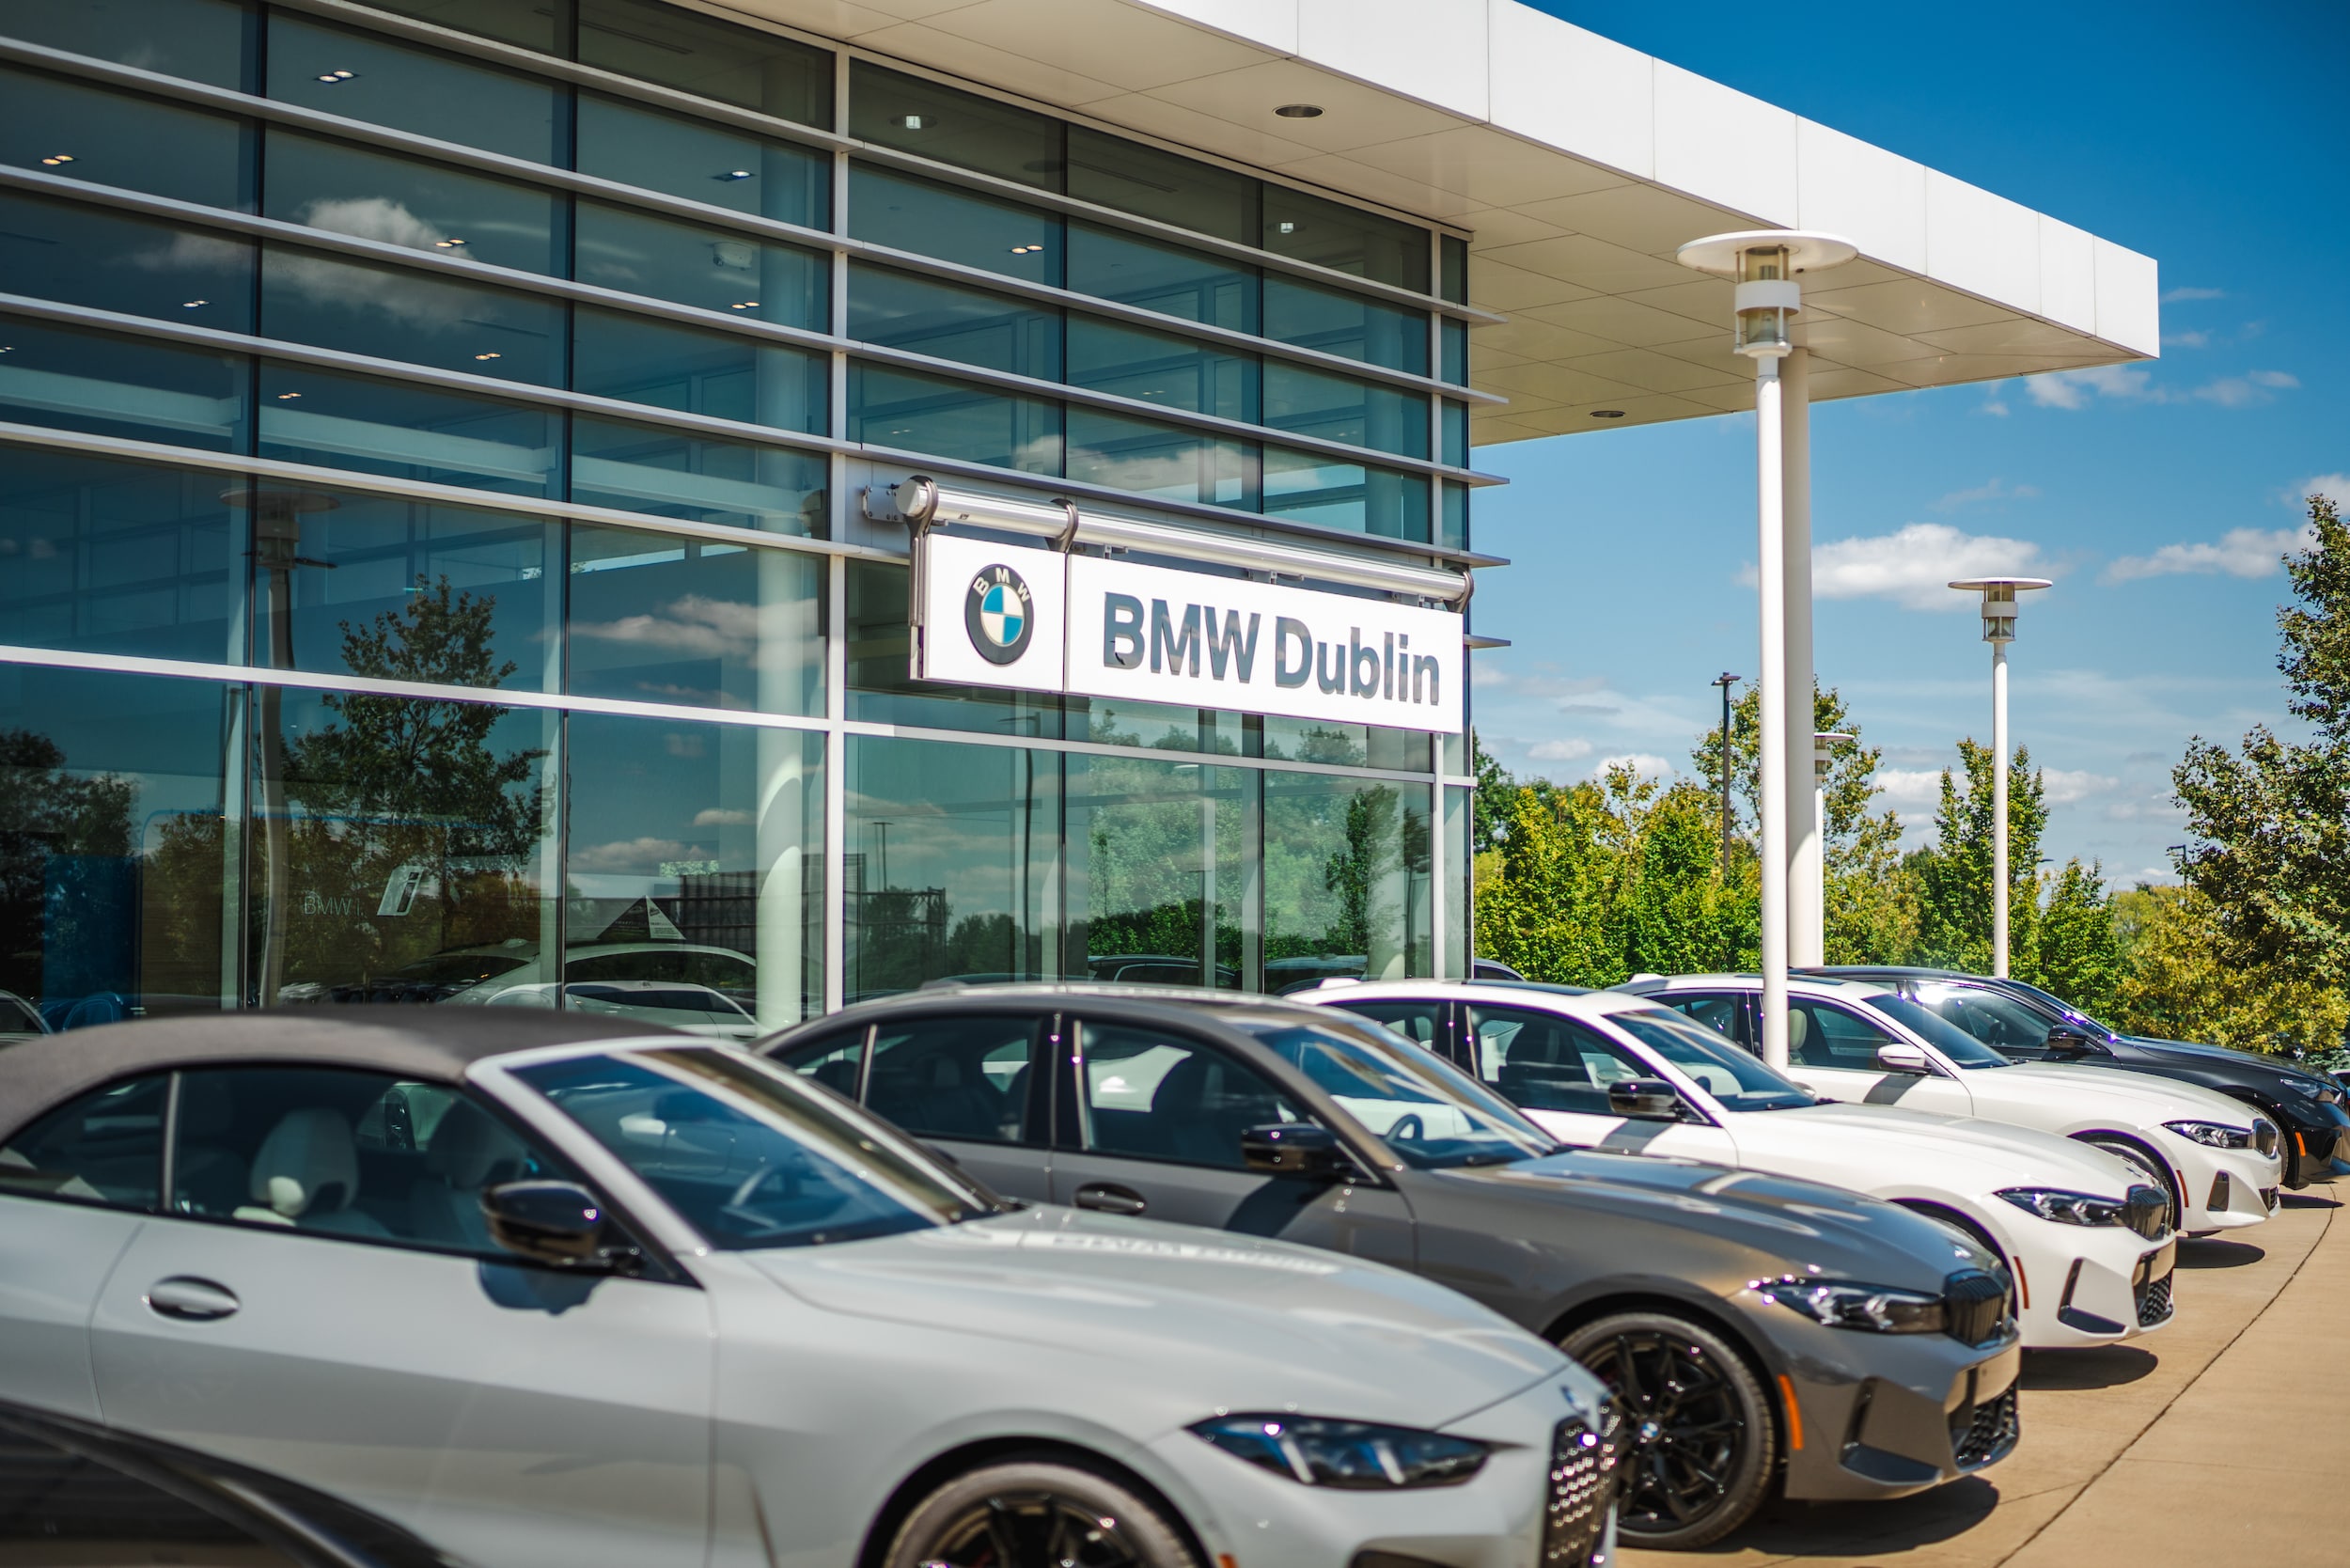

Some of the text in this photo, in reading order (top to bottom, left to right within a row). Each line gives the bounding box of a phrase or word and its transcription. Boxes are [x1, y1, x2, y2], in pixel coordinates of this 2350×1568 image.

[973, 567, 1031, 603] BMW
[1104, 591, 1440, 706] BMW Dublin
[304, 895, 353, 916] BMW
